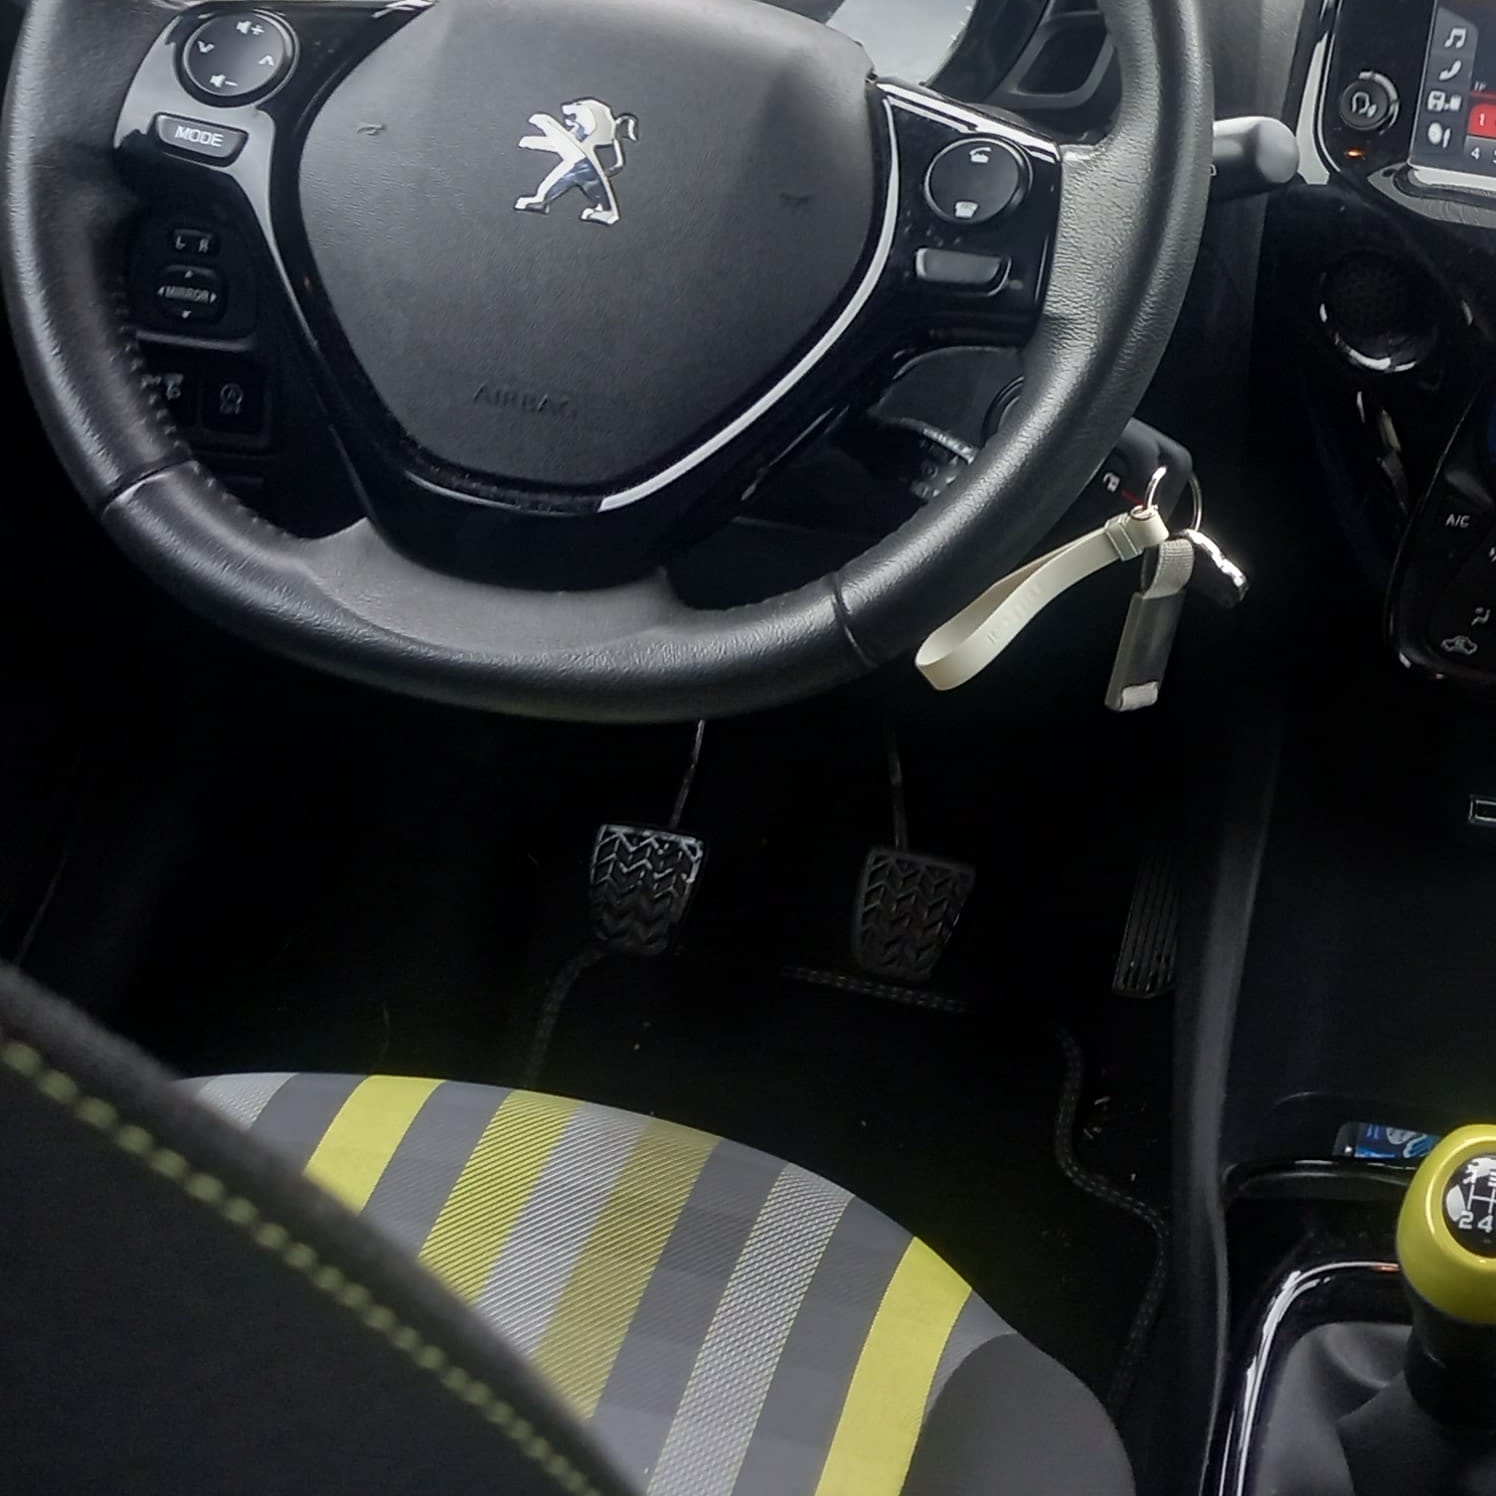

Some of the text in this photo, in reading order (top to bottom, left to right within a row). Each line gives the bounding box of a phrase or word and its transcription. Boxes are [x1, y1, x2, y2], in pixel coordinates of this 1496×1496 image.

[1479, 113, 1485, 126] 1
[174, 125, 224, 147] MODE
[1471, 147, 1480, 160] 4
[165, 285, 209, 303] MIRROR
[1445, 513, 1471, 529] A/C
[1458, 1210, 1474, 1230] 2
[1477, 1215, 1493, 1233] 4
